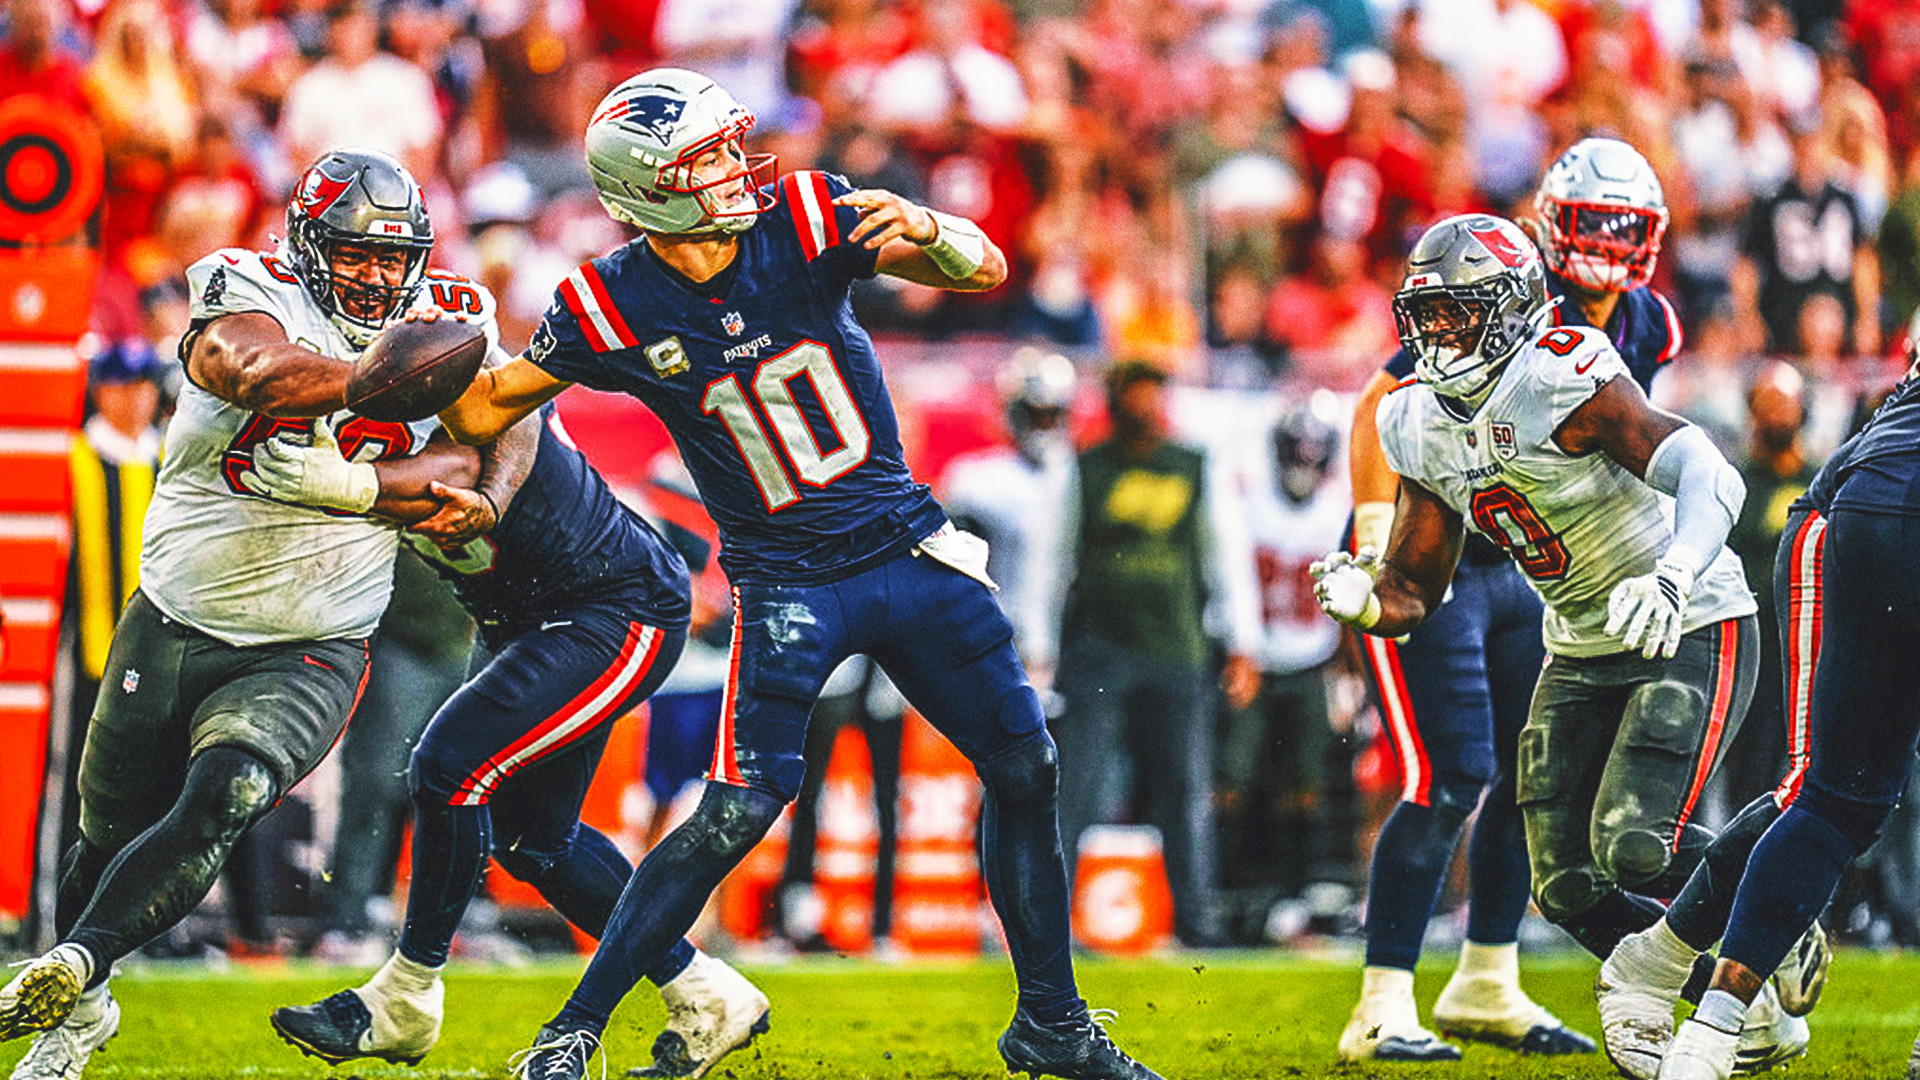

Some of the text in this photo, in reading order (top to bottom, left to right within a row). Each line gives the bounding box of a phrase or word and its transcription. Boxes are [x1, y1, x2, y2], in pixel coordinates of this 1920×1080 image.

[649, 340, 682, 370] C
[700, 338, 871, 514] 10
[1492, 426, 1512, 444] 50
[1469, 481, 1572, 581] 0
